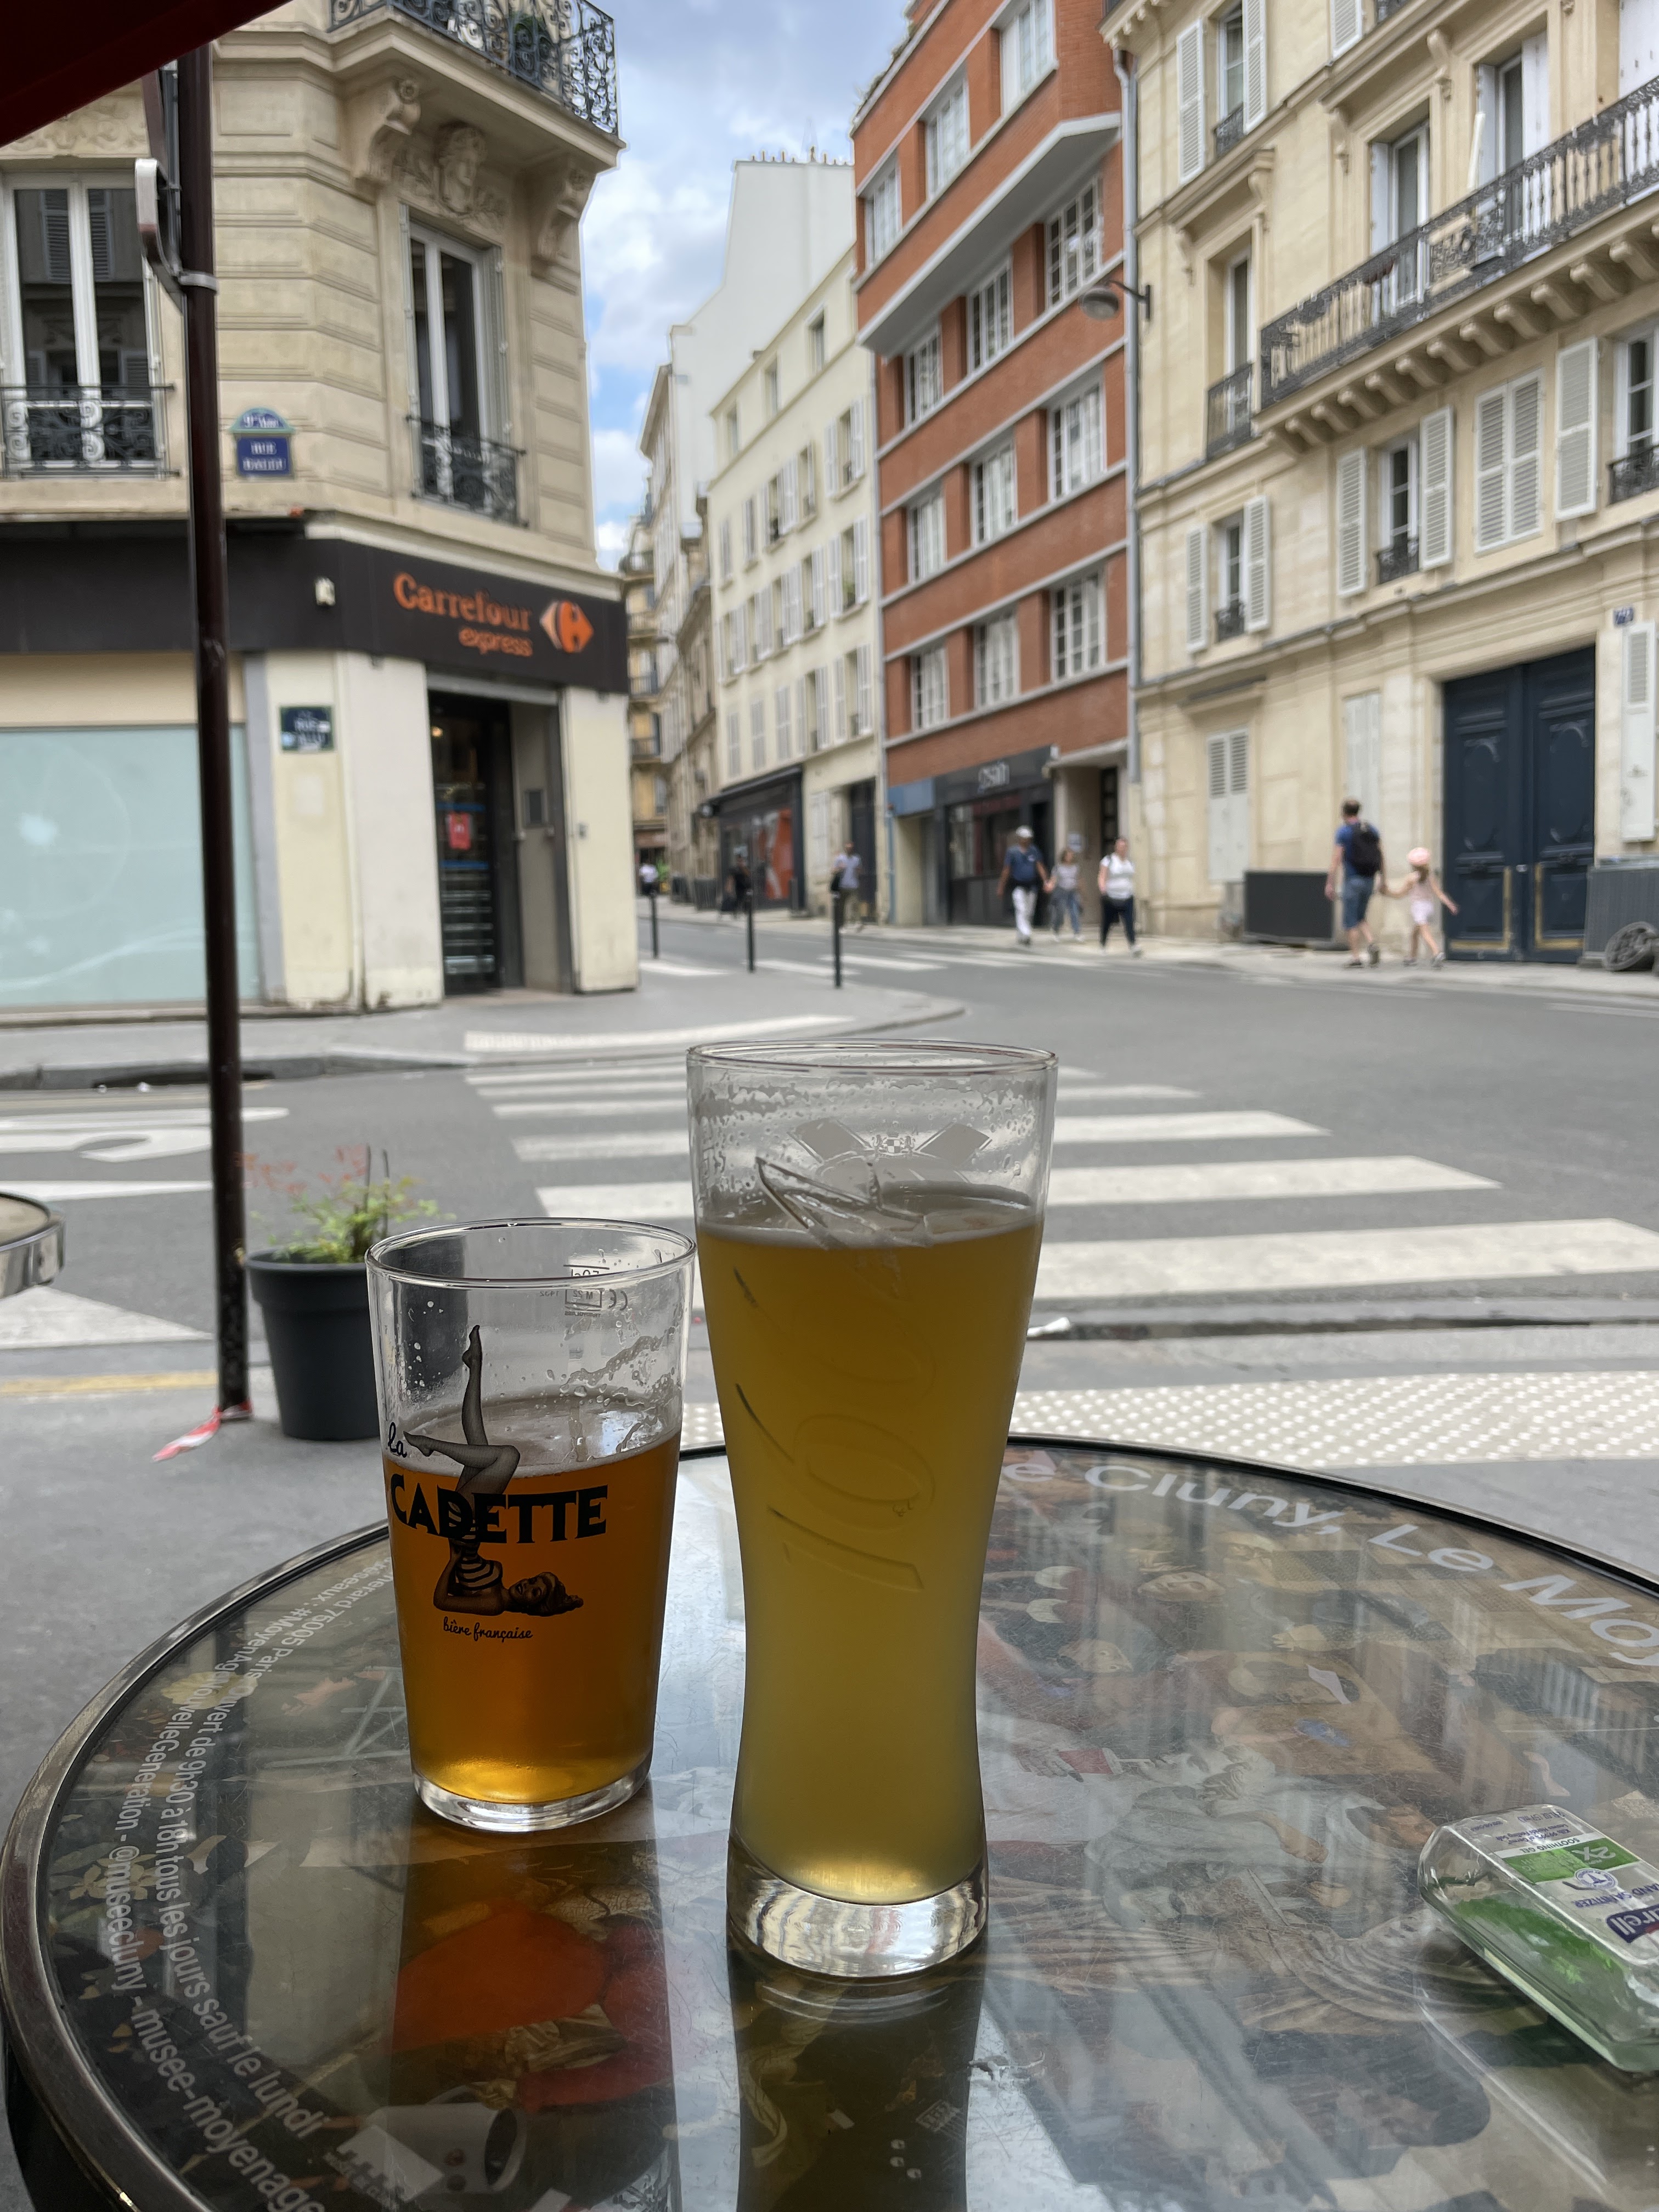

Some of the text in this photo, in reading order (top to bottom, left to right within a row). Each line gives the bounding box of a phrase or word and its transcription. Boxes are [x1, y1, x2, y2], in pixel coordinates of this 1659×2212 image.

[393, 571, 531, 632] Carrefour
[387, 1421, 407, 1458] la
[391, 1473, 608, 1544] CADETTE
[1084, 1465, 1346, 1534] Cluny,
[1367, 1523, 1494, 1572] Le
[280, 1609, 346, 1646] 75005
[443, 1616, 534, 1643] bière française
[246, 1646, 294, 1679] Paris
[185, 1737, 216, 1757] de
[165, 1759, 207, 1804] 9h30
[160, 1807, 191, 1820] à
[155, 1820, 189, 1854] 18h
[1537, 1837, 1581, 1852] SOOTHING
[1571, 1846, 1616, 1861] 2X
[154, 1855, 185, 1902] tous
[105, 1844, 148, 1990] @museecluny
[158, 1901, 191, 1938] les
[159, 1936, 211, 1999] jours
[192, 1998, 253, 2050] sauf
[227, 2046, 262, 2077] le
[247, 2070, 331, 2139] lundi
